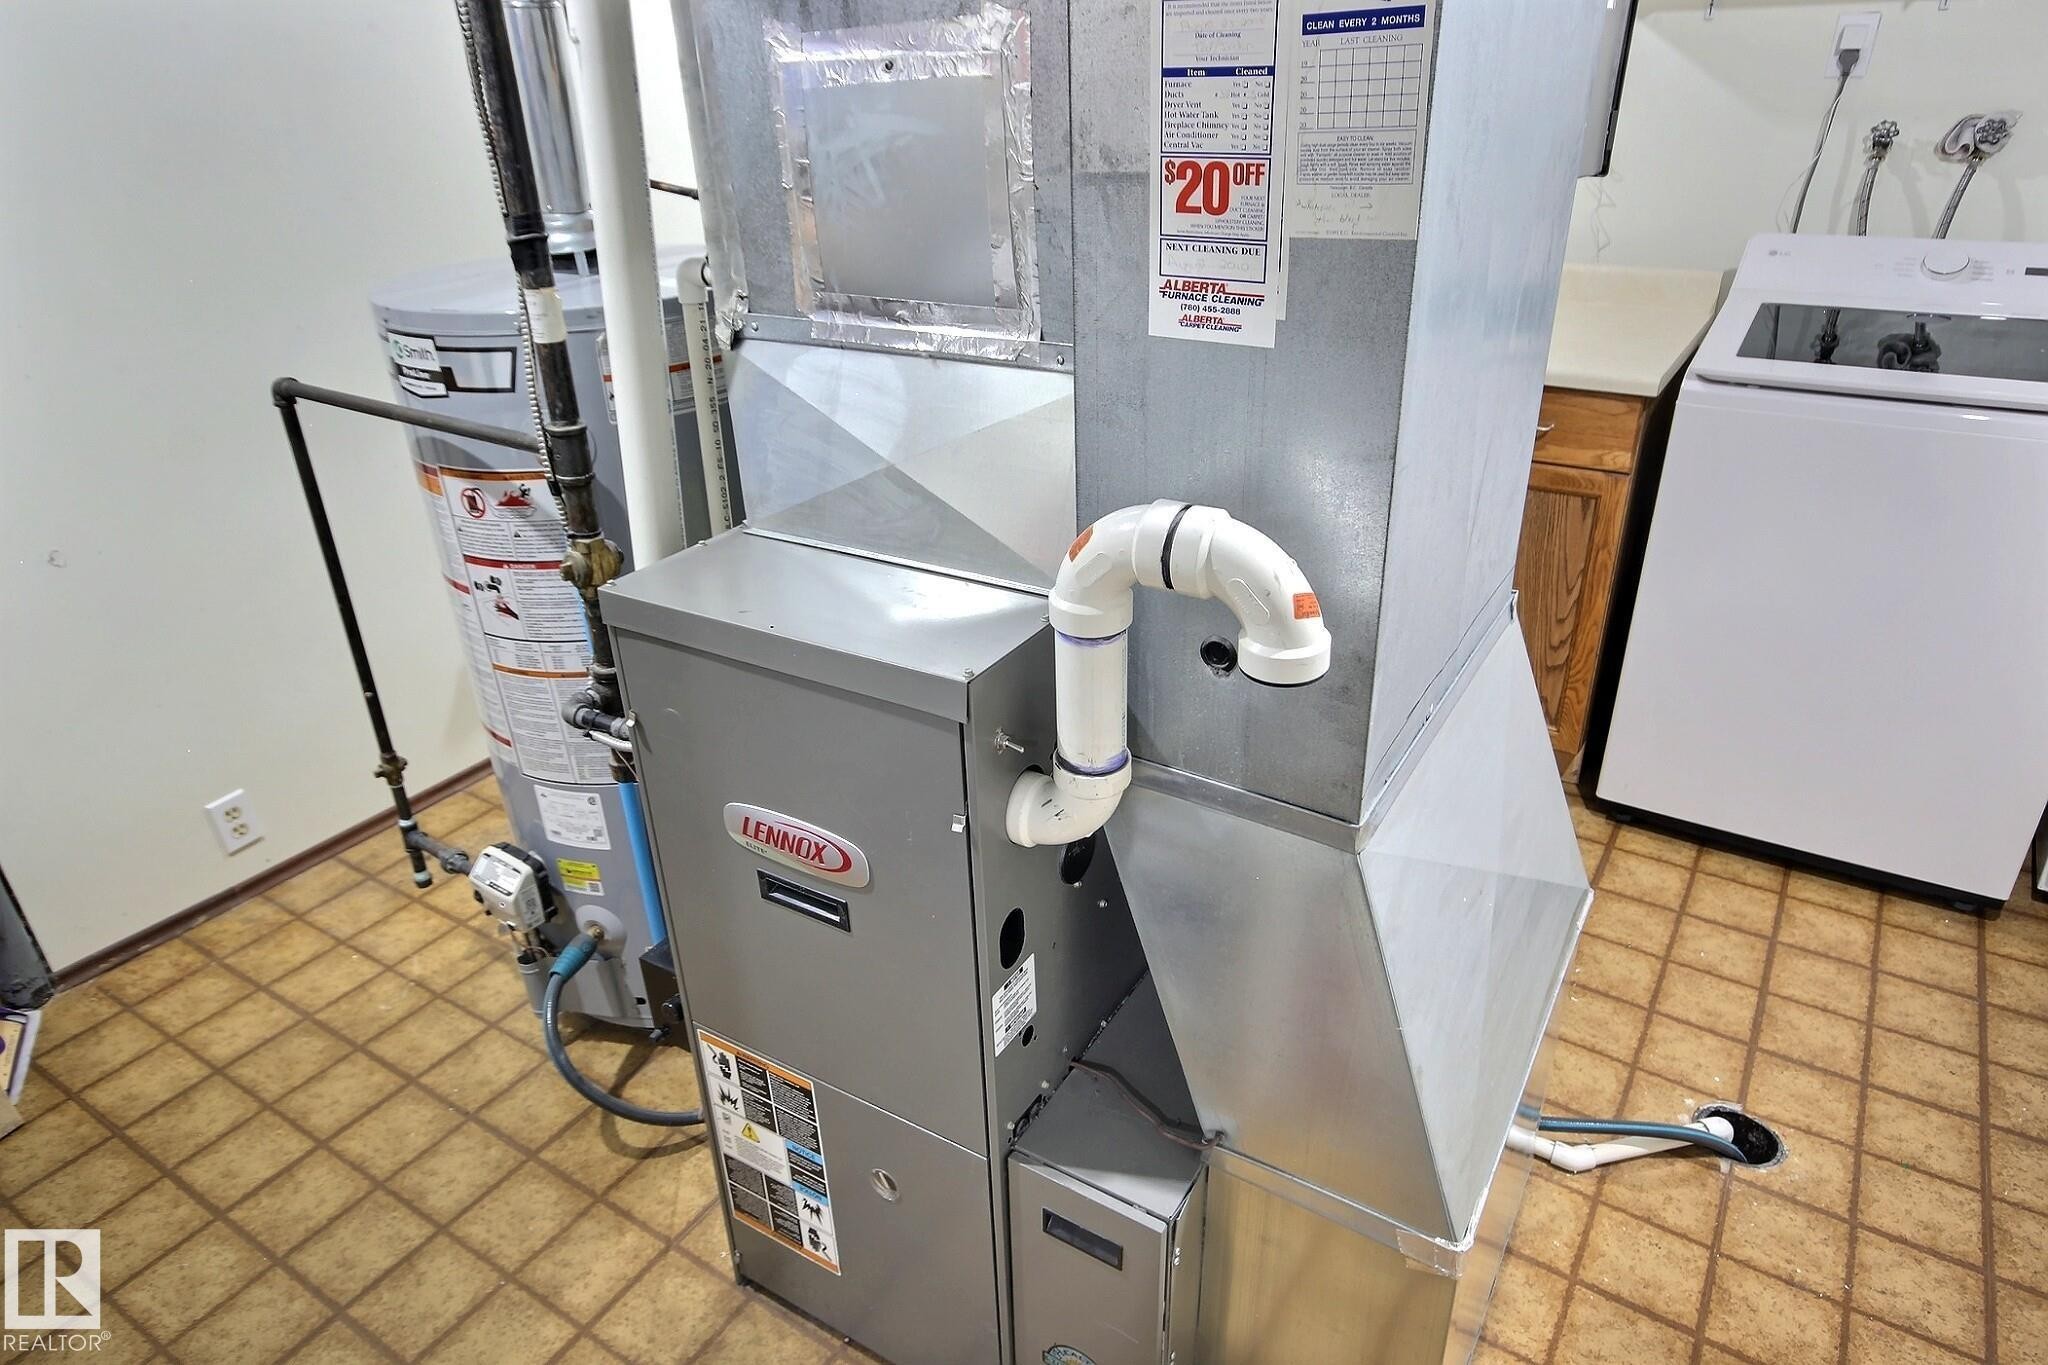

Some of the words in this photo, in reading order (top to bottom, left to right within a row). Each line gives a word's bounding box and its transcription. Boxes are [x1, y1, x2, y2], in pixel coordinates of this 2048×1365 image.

[1306, 20, 1335, 30] CLEAN
[1339, 17, 1368, 28] EVERY
[1371, 17, 1377, 26] 2
[1381, 13, 1421, 25] MONTHS
[1301, 39, 1320, 48] YEAR
[1340, 36, 1360, 45] LAST
[1363, 34, 1403, 44] CLEANING
[1187, 68, 1206, 77] Item
[1235, 66, 1269, 76] Cleaned
[1164, 80, 1192, 88] Furnace
[1164, 101, 1184, 110] Dryer
[1185, 101, 1202, 109] Vent
[1164, 111, 1178, 119] Hot
[1179, 111, 1200, 119] Water
[1201, 111, 1219, 119] Tank
[1164, 121, 1195, 130] Fireplace
[1196, 121, 1229, 130] Chimney
[1164, 141, 1190, 149] Central
[1190, 141, 1203, 149] Vac
[1164, 159, 1230, 216] $20
[1232, 163, 1266, 187] OFF
[1166, 242, 1191, 252] NEXT
[1192, 244, 1238, 255] CLEANING
[1241, 248, 1261, 257] DUE
[1163, 279, 1227, 295] ALBERTA
[1161, 291, 1208, 303] FURNACE
[1211, 295, 1263, 306] CLEANING
[1180, 303, 1201, 313] (780)
[1202, 305, 1241, 316] 455-2888
[1181, 314, 1224, 325] ALBERTA
[1206, 323, 1240, 333] CLEANING
[742, 816, 829, 865] LENNOX
